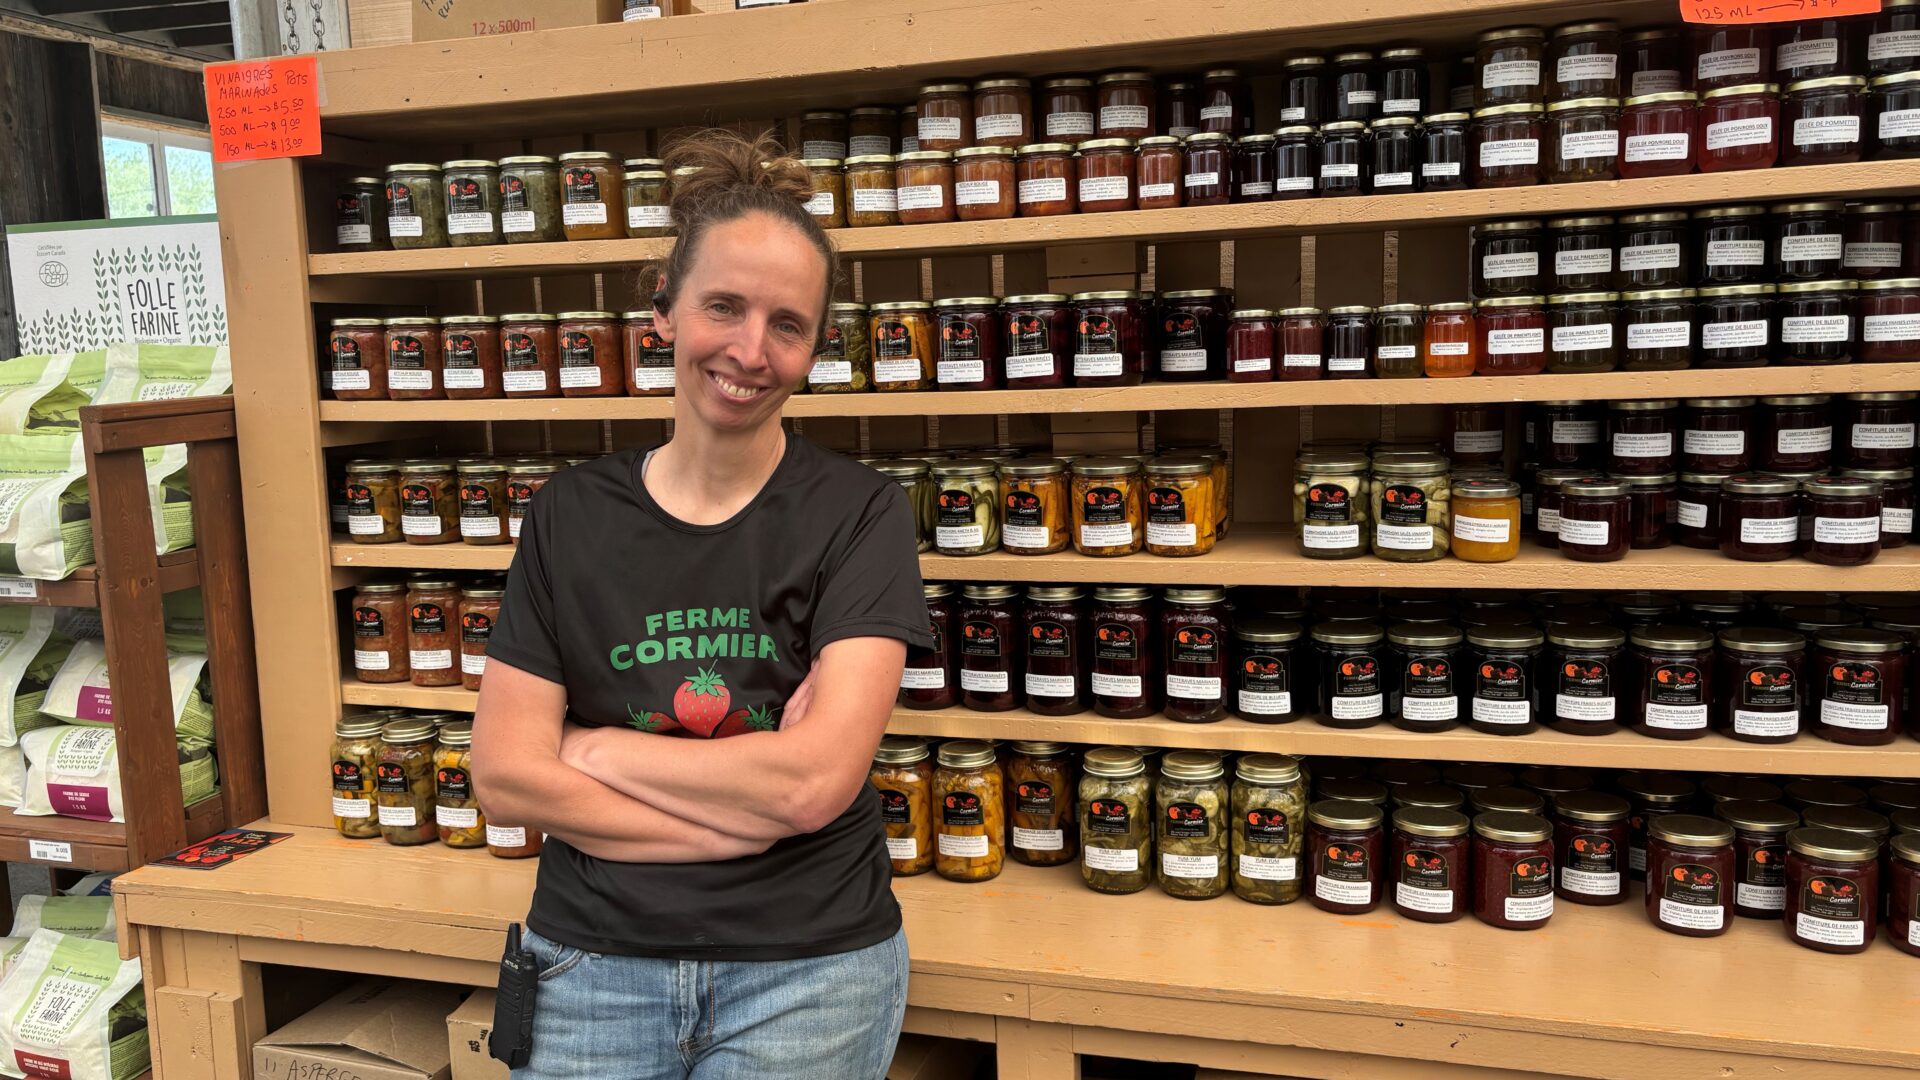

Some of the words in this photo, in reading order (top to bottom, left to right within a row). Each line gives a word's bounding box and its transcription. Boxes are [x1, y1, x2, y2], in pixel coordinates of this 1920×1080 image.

[1695, 8, 1724, 20] 125
[472, 22, 486, 36] 12
[489, 24, 497, 34] x
[498, 17, 536, 34] 500ml
[217, 107, 237, 119] 250
[1815, 119, 1824, 127] DE
[219, 125, 237, 137] 500
[222, 142, 240, 156] 750
[127, 277, 175, 311] FOLLE
[131, 311, 181, 336] FARINE
[1324, 501, 1345, 510] Cormier
[1400, 502, 1421, 511] Cormier
[645, 607, 750, 636] FERME
[609, 633, 780, 671] CORMIER
[1426, 675, 1447, 683] Cormier
[1497, 678, 1518, 686] Cormier
[1581, 677, 1603, 685] Cormier
[1850, 680, 1875, 689] Cormier
[80, 729, 109, 740] FOLLE
[73, 739, 99, 750] FARINE
[1106, 814, 1125, 822] Cormier
[1184, 818, 1204, 827] Cormier
[1691, 883, 1715, 891] Cormier
[1829, 896, 1854, 904] Cormier
[1666, 903, 1693, 913] CONFITURE
[1701, 908, 1719, 916] FRAISES
[1802, 917, 1832, 928] CONFITURE
[1832, 921, 1840, 930] DE
[1840, 923, 1859, 931] FRAISES
[47, 996, 77, 1012] FOLLE
[39, 1009, 66, 1024] FARINE
